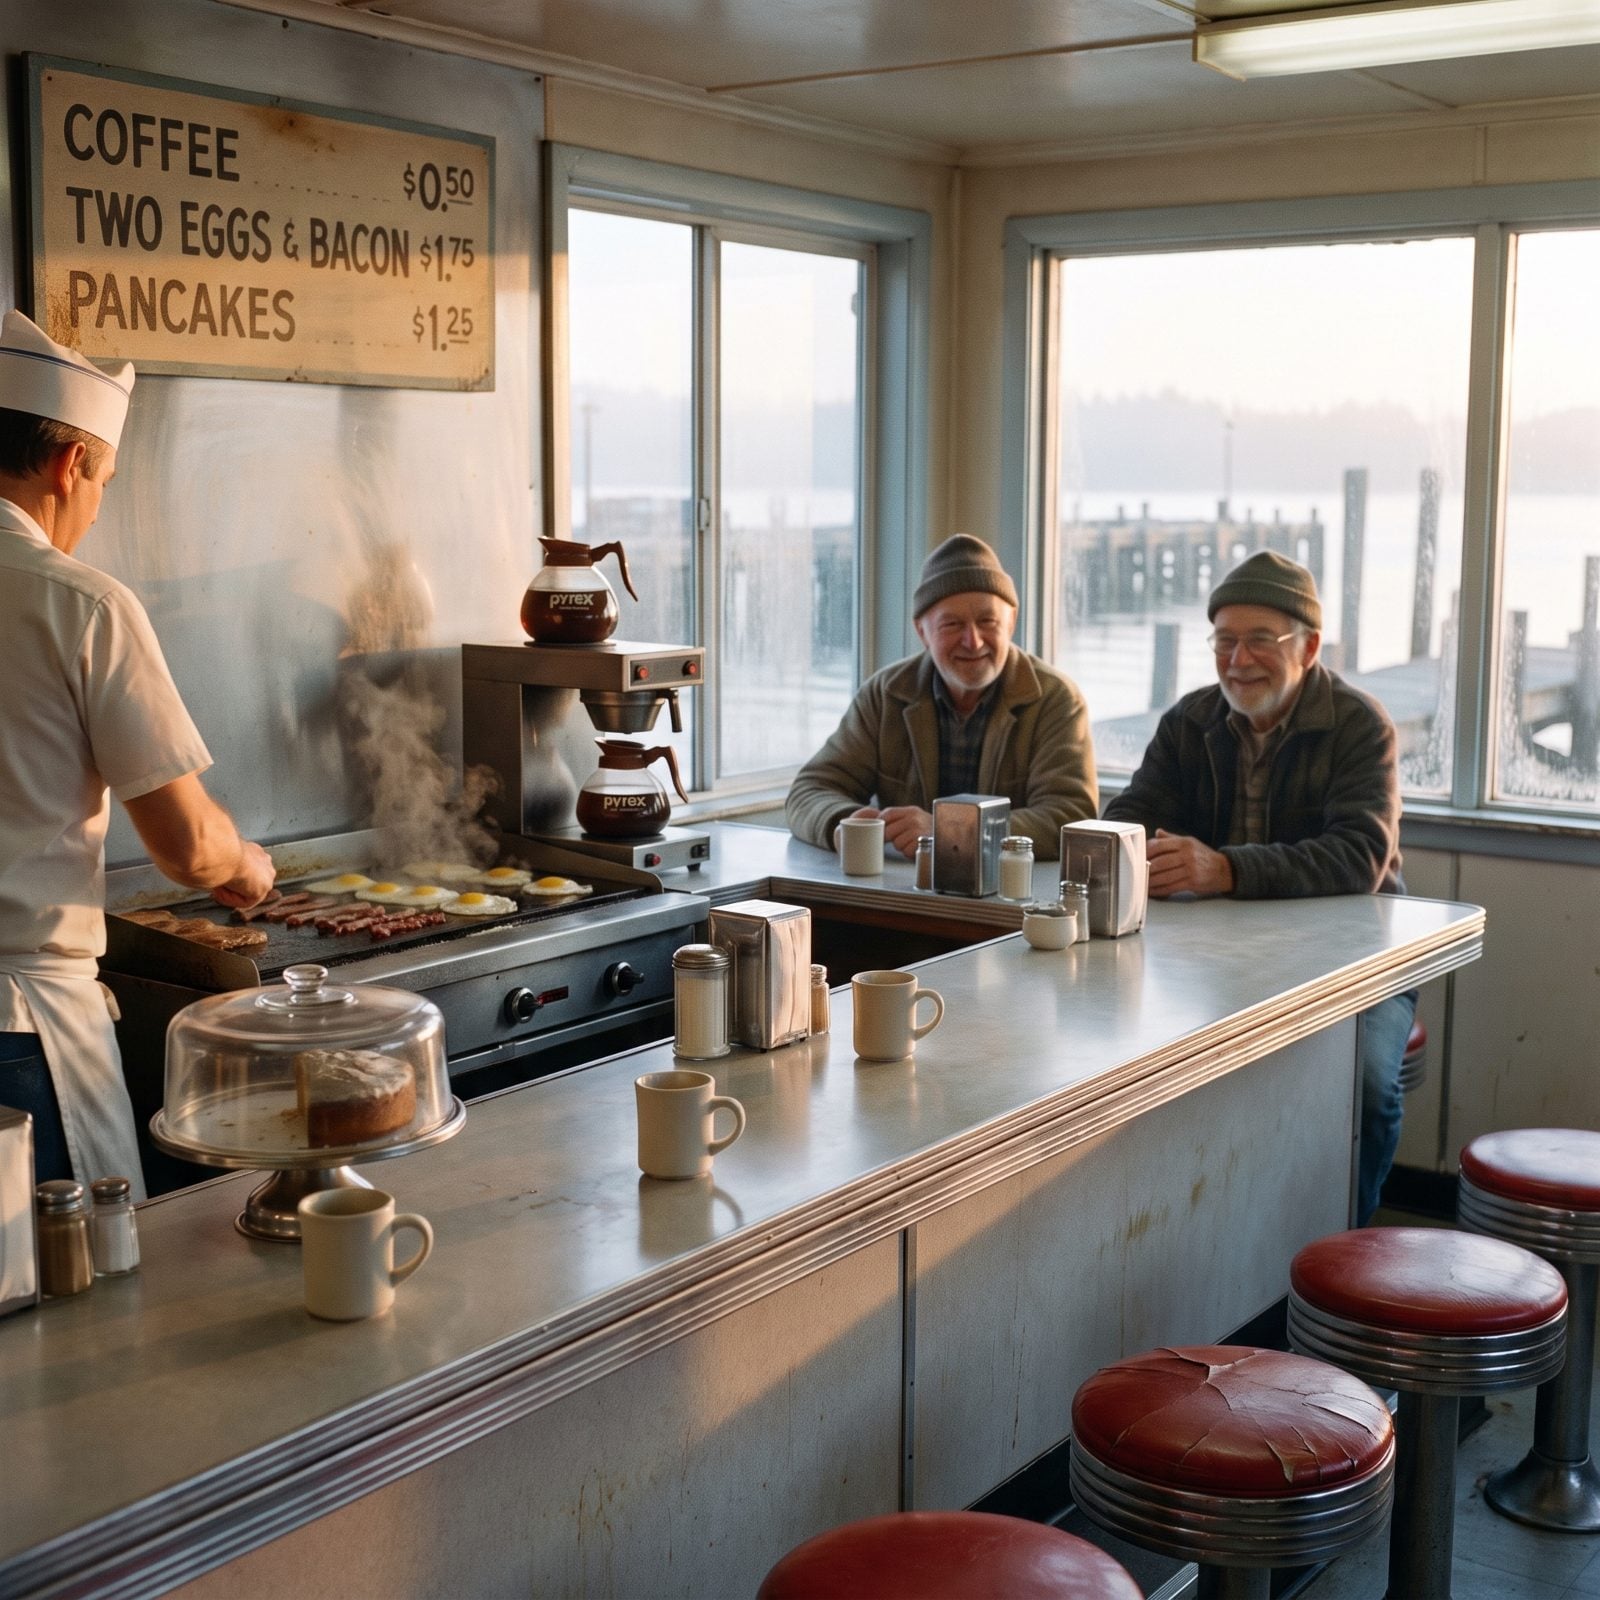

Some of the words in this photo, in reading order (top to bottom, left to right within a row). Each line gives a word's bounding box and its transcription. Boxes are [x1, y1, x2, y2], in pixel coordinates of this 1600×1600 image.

[63, 103, 240, 182] COFFEE
[403, 162, 475, 213] $0.50
[65, 186, 163, 252] TWO
[180, 200, 272, 263] EGGS
[283, 218, 300, 262] &
[309, 218, 410, 279] BACON
[420, 235, 475, 283] $1.75
[69, 270, 296, 343] PANCAKES
[412, 304, 474, 352] $1.25
[549, 593, 594, 609] pyrex
[603, 796, 647, 810] pyrex
